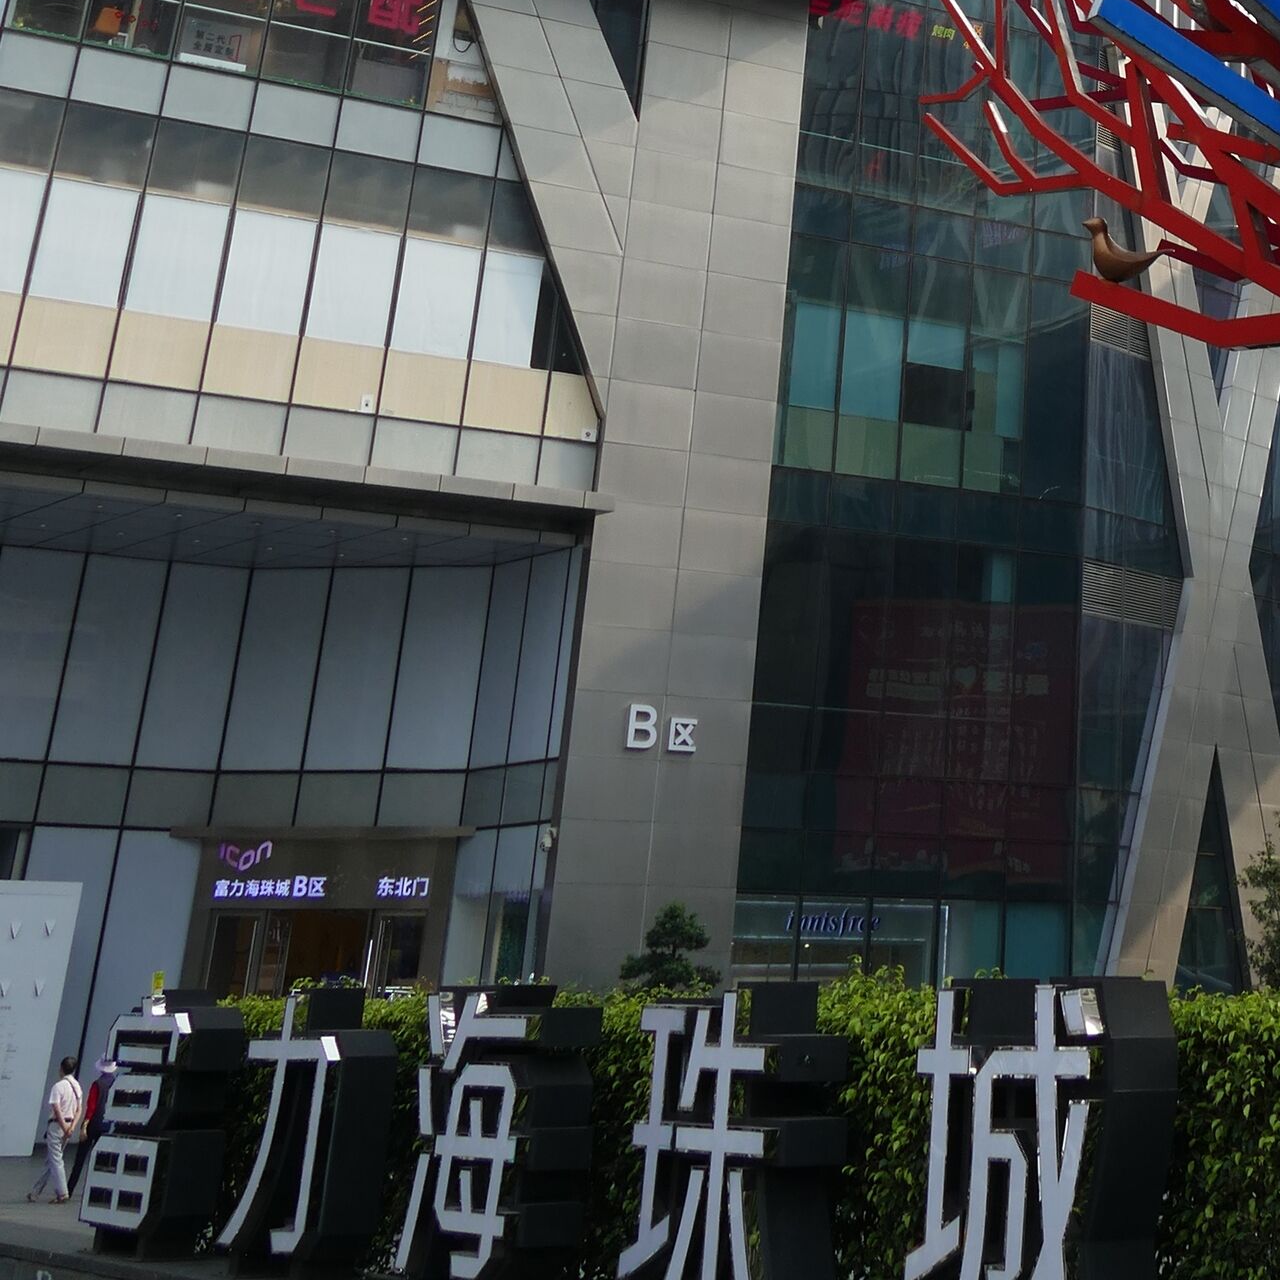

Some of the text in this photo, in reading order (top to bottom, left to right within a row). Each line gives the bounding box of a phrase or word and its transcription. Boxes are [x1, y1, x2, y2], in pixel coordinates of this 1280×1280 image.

[625, 703, 698, 754] B区
[376, 876, 430, 898] 东北门
[78, 983, 1104, 1280] 富力海珠城
